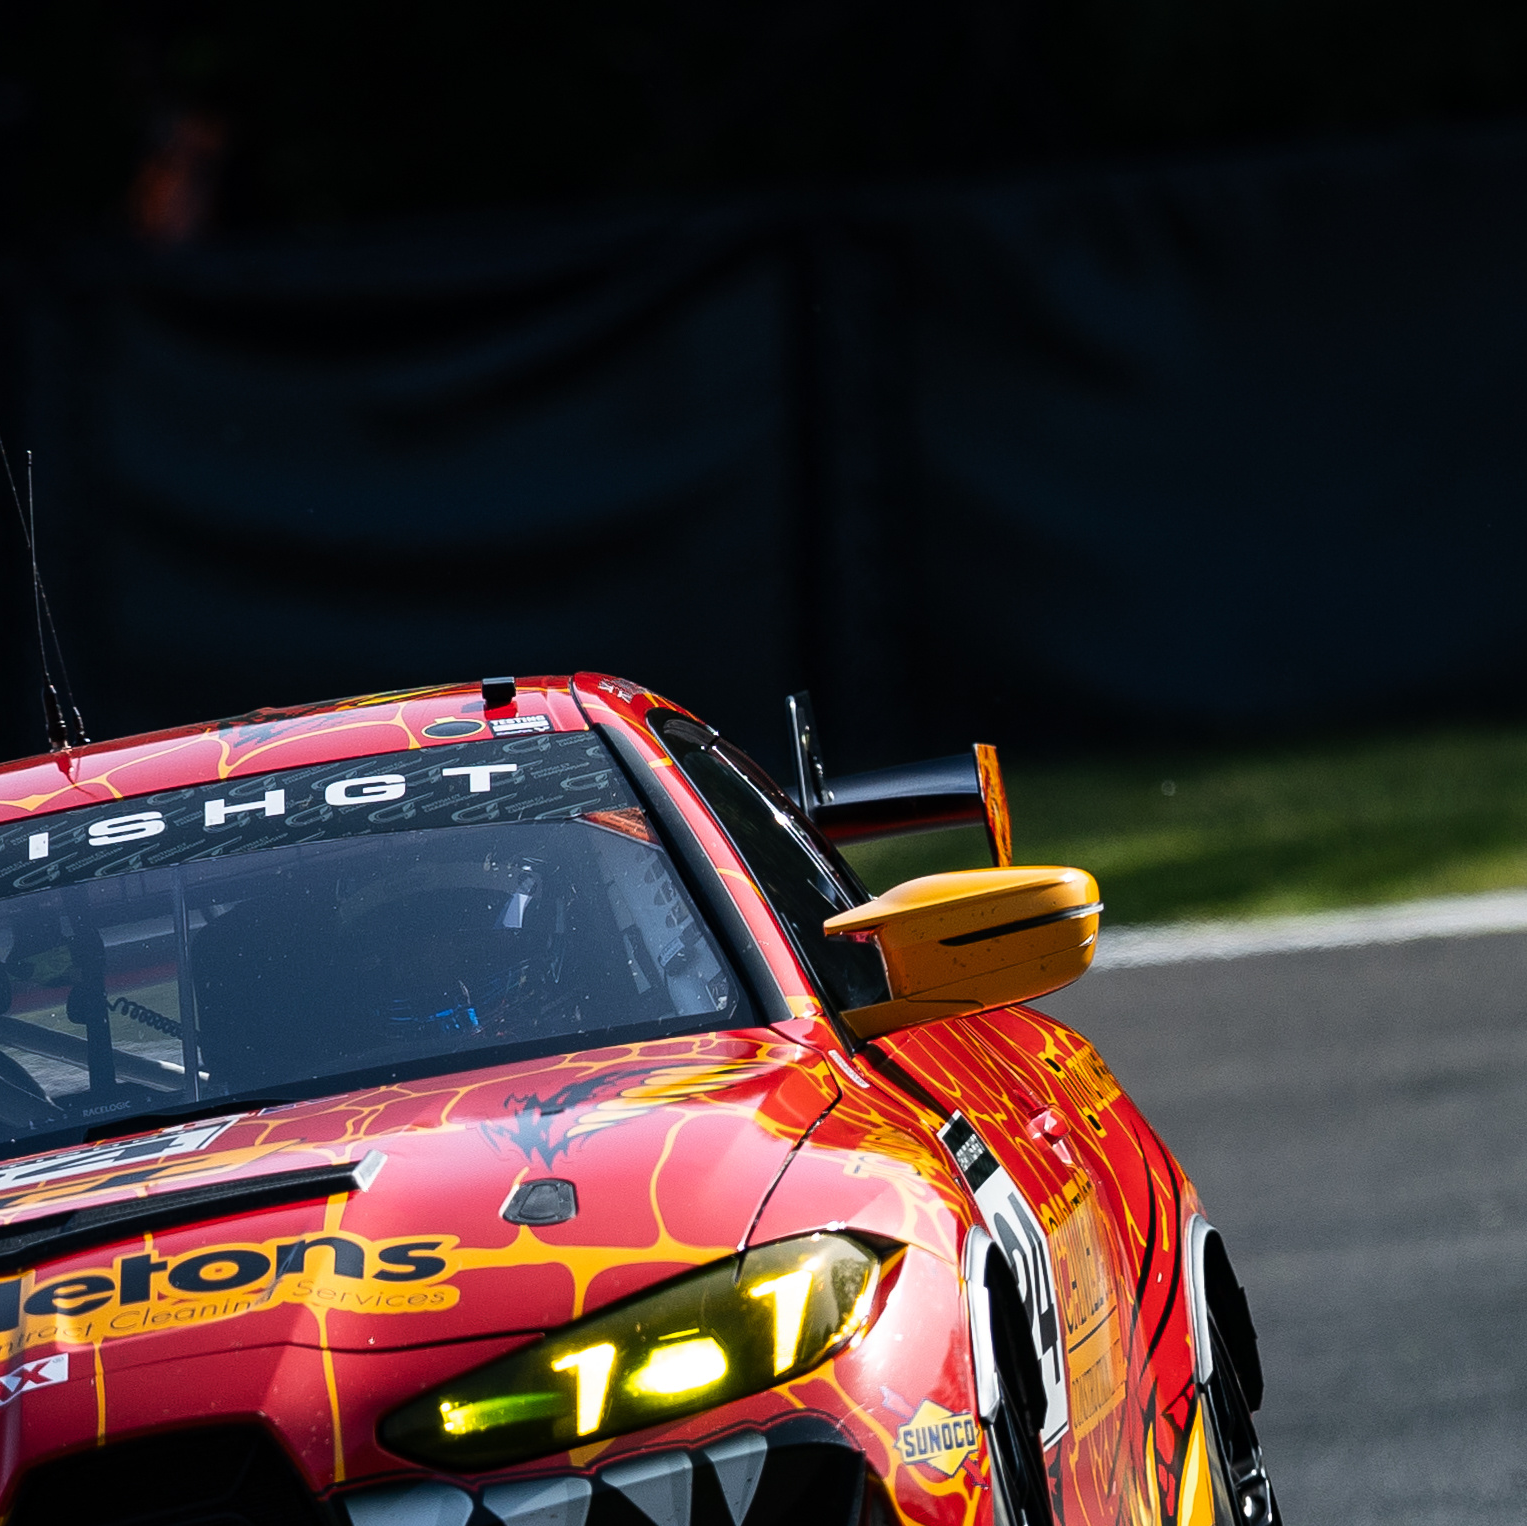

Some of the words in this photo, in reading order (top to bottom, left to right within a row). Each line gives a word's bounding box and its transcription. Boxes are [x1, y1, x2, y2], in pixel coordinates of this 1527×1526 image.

[82, 1101, 131, 1117] RACELOGIC
[109, 1295, 262, 1331] Cleanin
[292, 1279, 445, 1308] Services
[903, 1418, 976, 1458] SUNOCO
